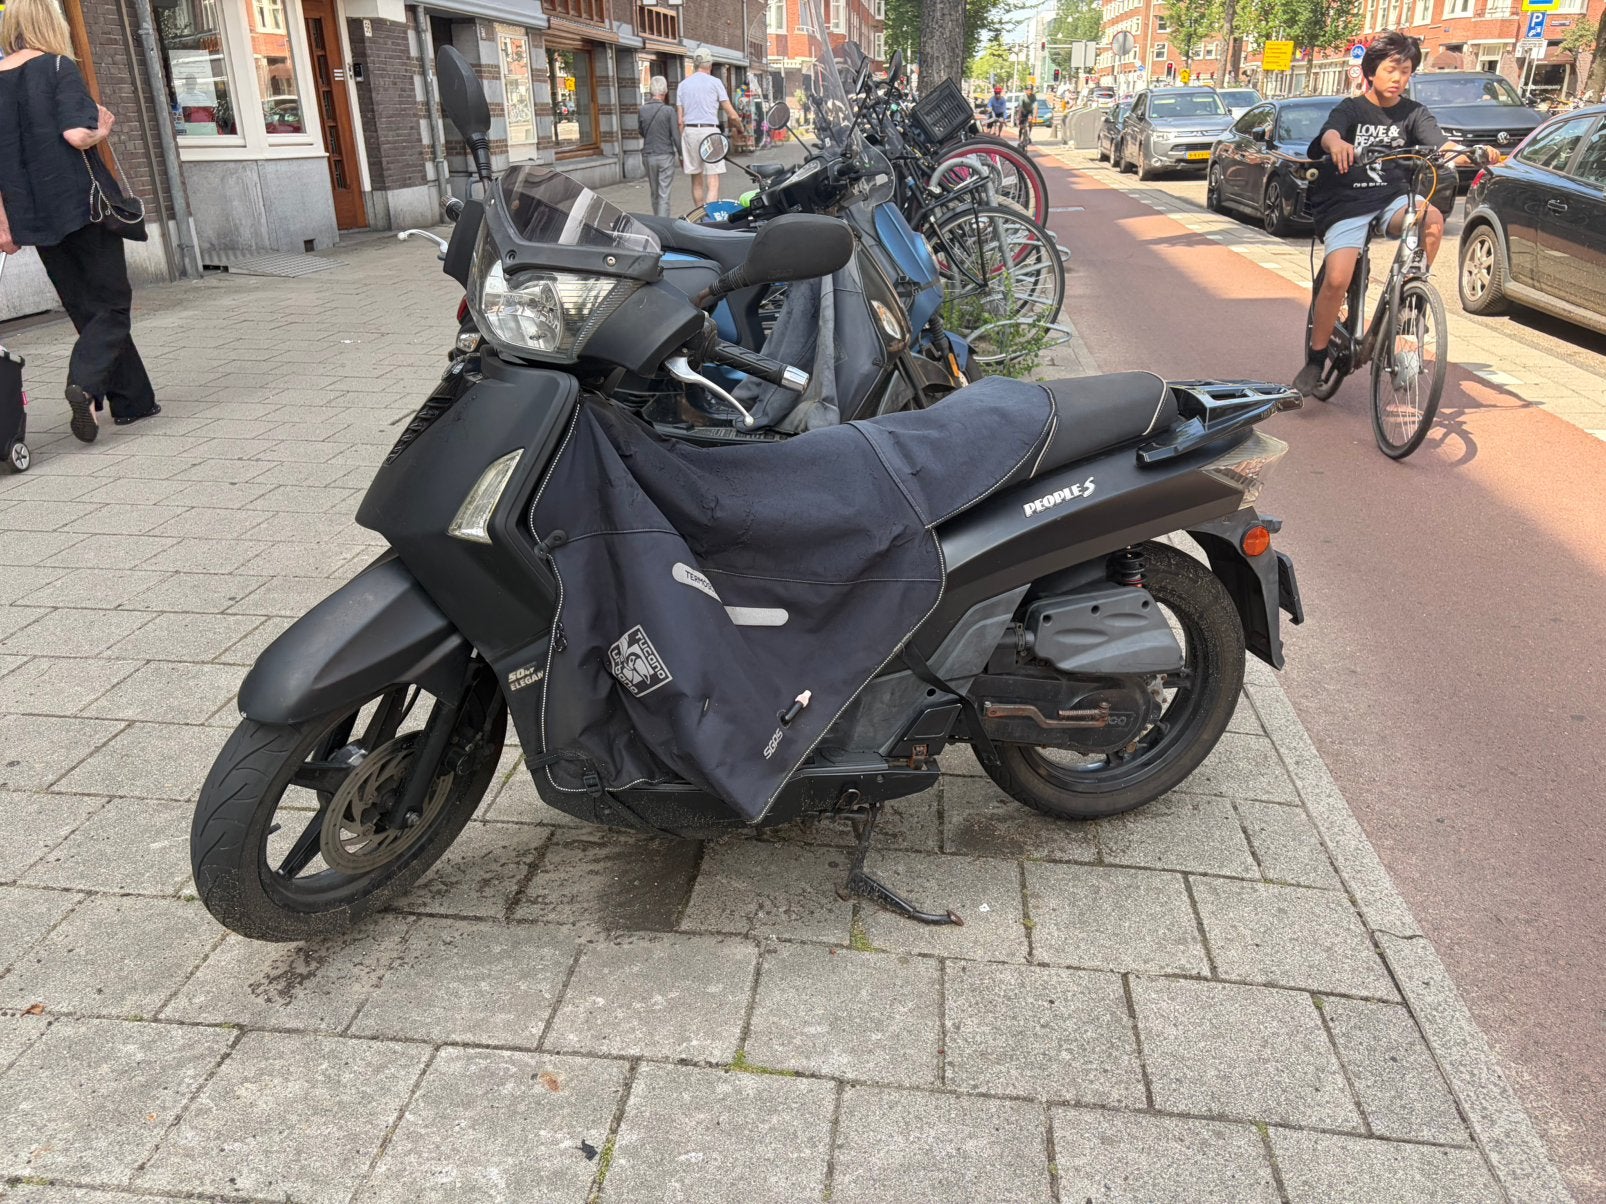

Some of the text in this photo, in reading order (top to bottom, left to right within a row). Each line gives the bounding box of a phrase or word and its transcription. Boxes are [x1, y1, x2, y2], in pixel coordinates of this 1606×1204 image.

[1531, 13, 1543, 27] P
[1356, 123, 1400, 138] LOVE &
[1023, 476, 1097, 518] PEOPLE S
[685, 570, 715, 593] TERMOS
[510, 670, 544, 691] ELEGAN
